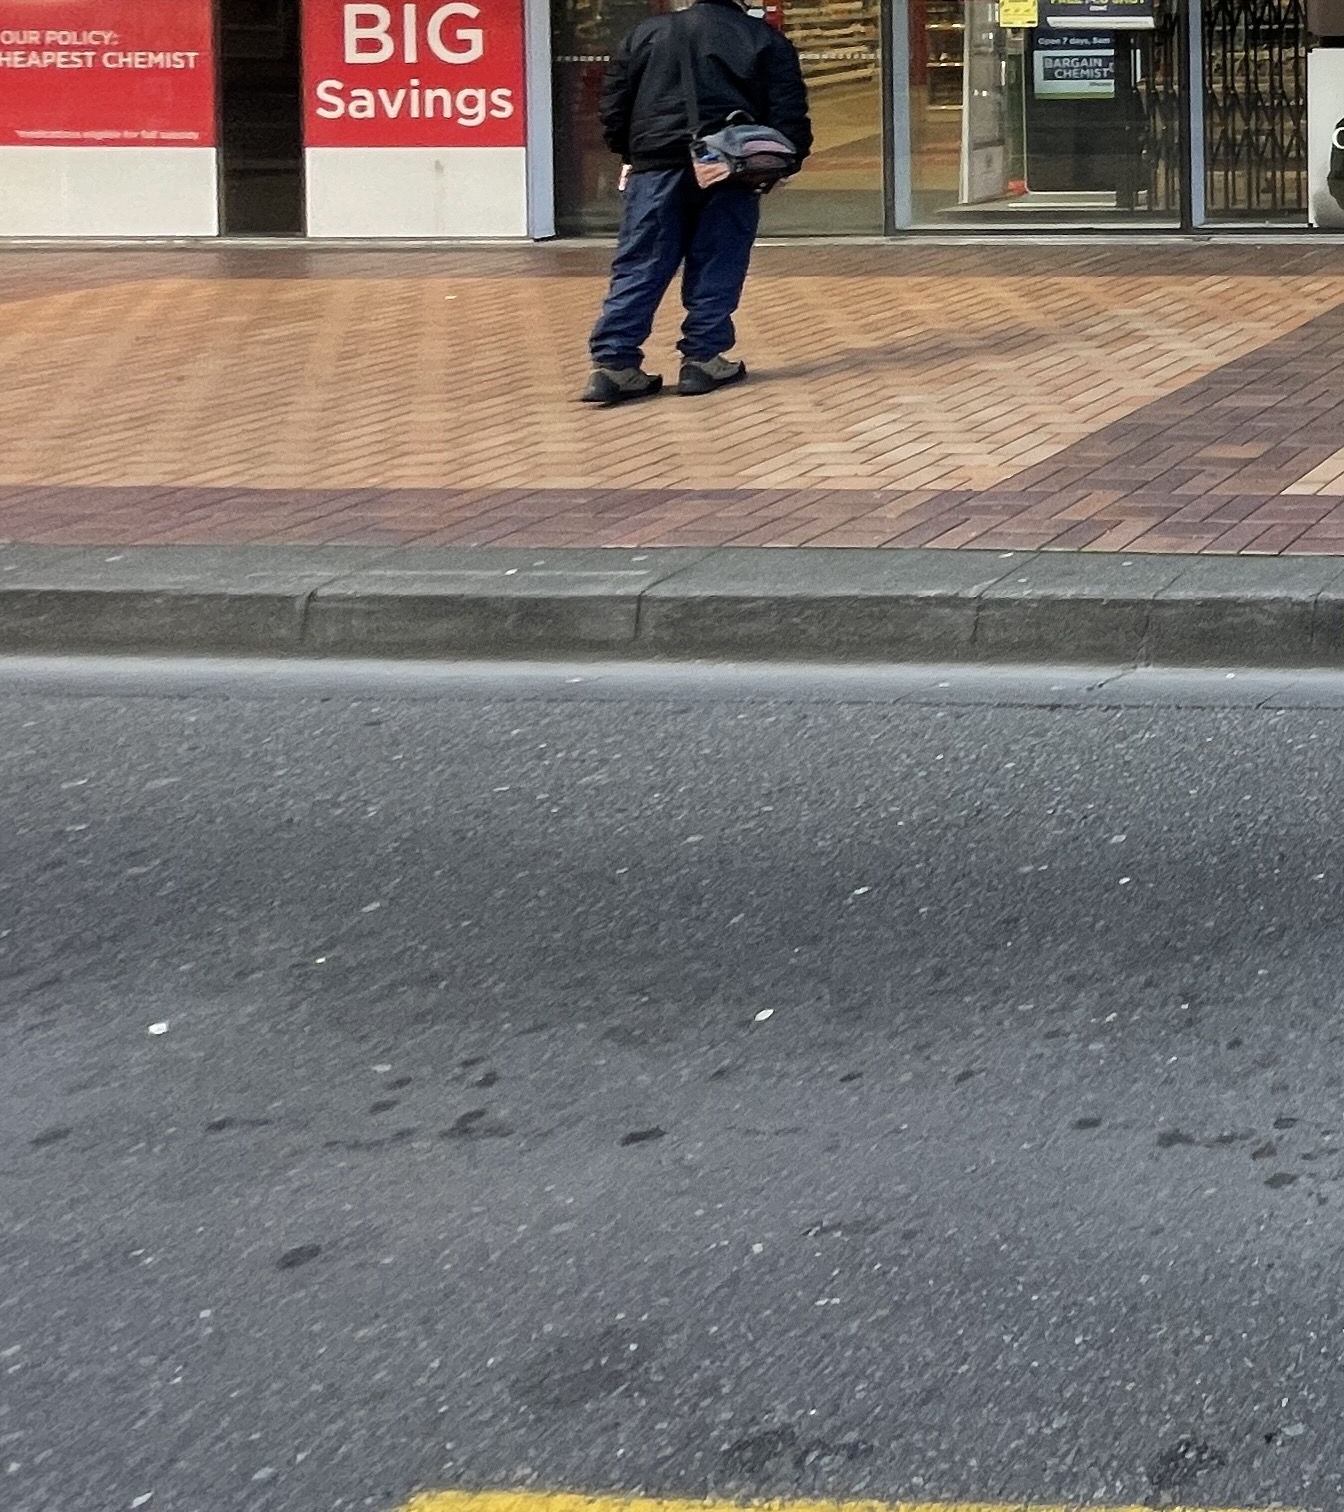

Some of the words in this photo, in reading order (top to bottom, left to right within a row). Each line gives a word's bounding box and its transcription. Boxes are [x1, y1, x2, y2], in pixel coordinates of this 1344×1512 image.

[1, 30, 41, 45] OUR
[45, 30, 120, 45] POLICY:
[344, 2, 484, 65] BIG
[102, 51, 199, 68] CHEMIST
[1044, 57, 1102, 68] BARGAIN
[1054, 68, 1108, 79] CHEMIST
[315, 78, 514, 127] Savings
